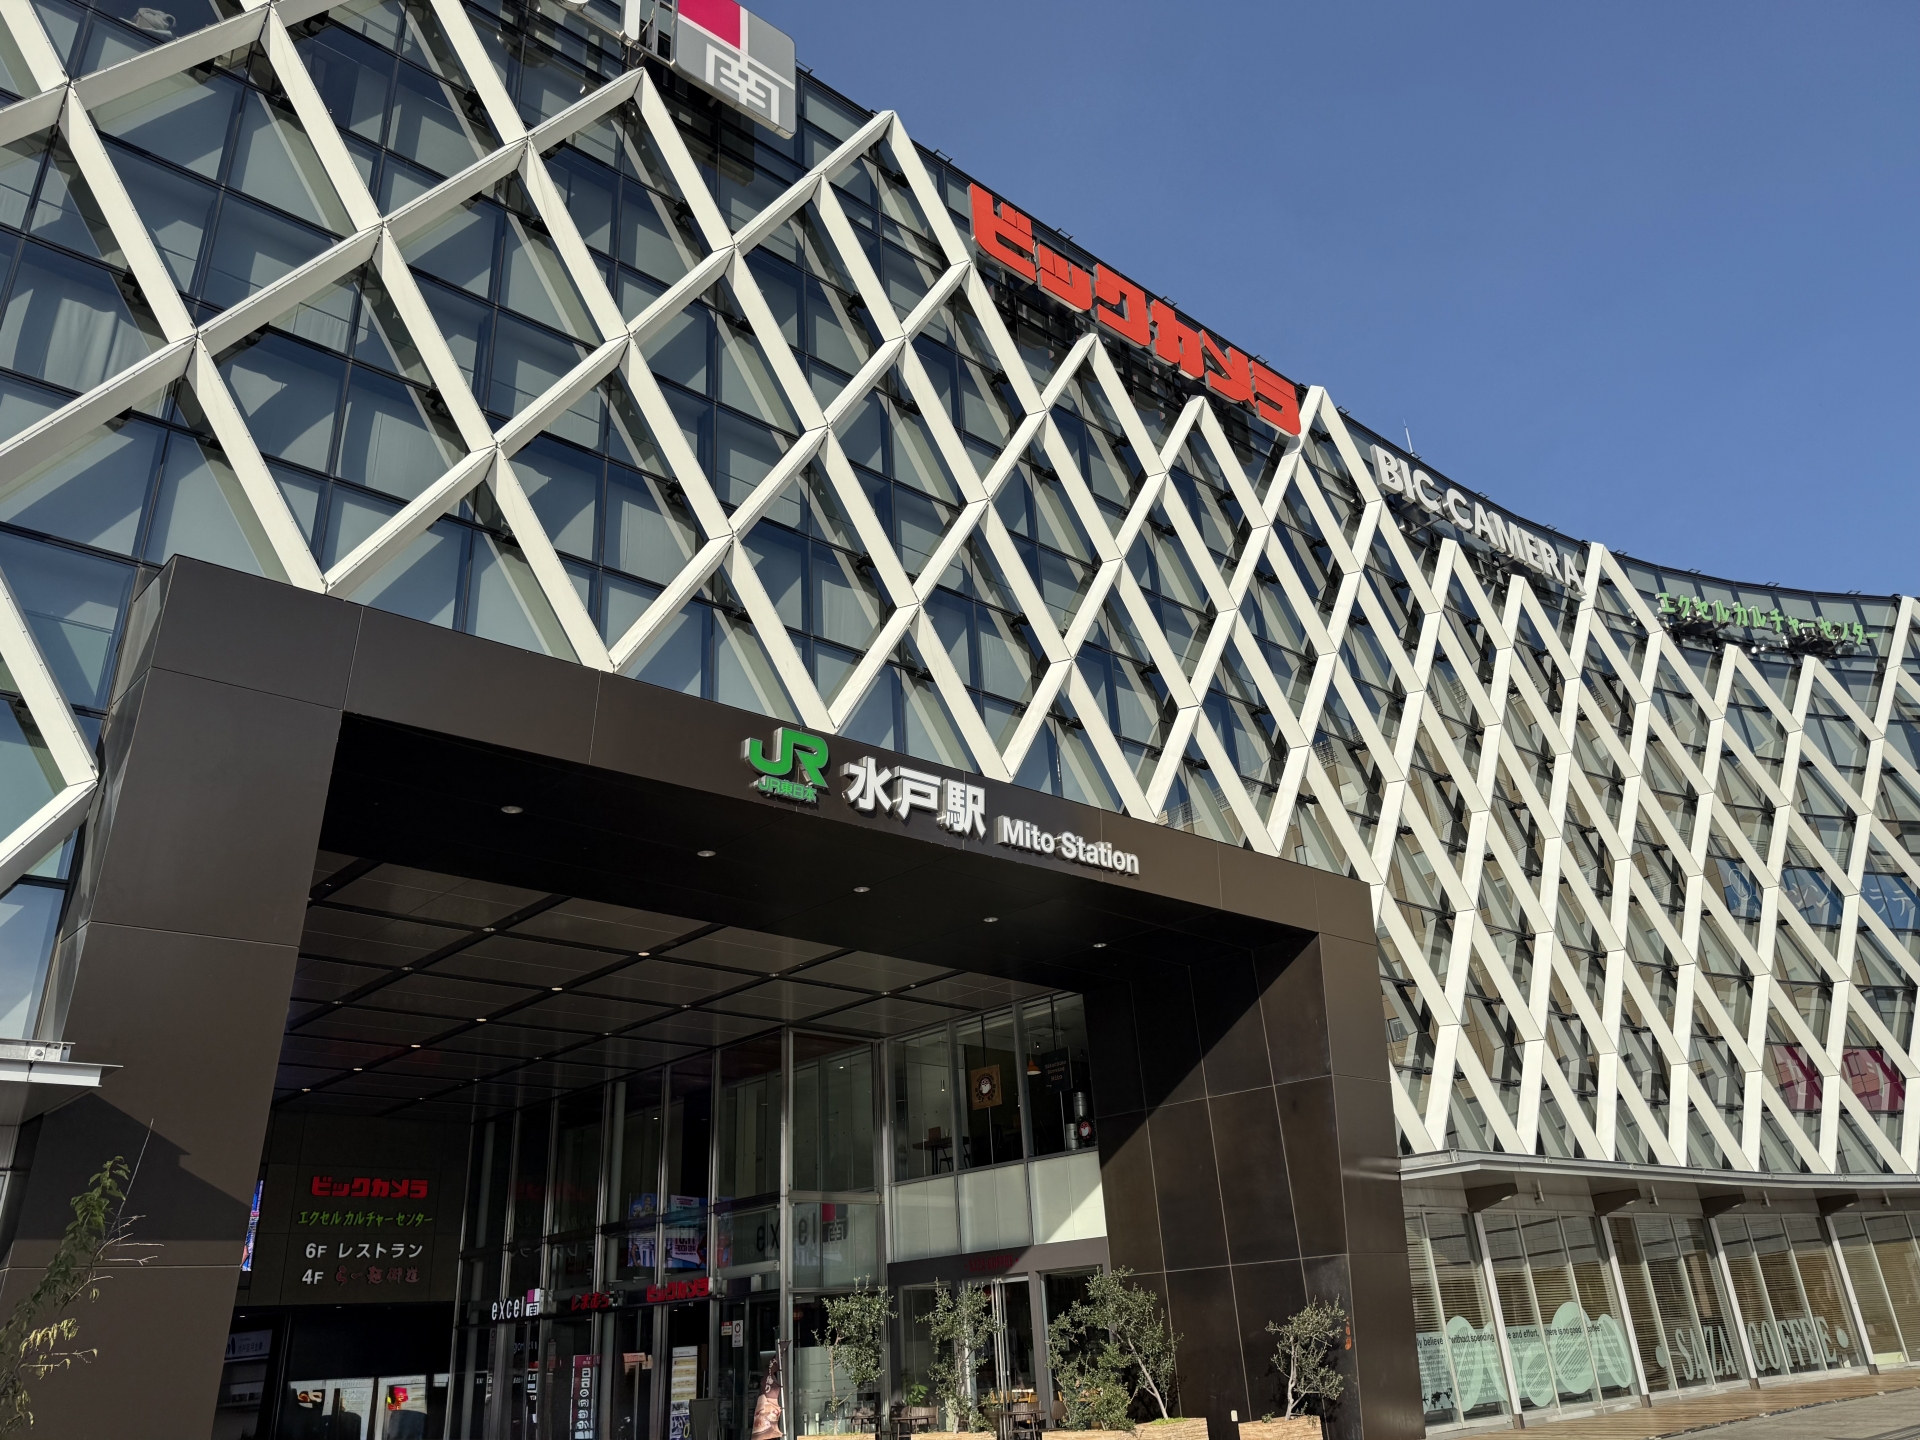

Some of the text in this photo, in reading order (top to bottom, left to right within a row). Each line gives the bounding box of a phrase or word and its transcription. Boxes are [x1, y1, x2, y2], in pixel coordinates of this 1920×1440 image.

[967, 182, 1301, 437] ビックカメラ
[1370, 443, 1587, 597] BIC CAMERA
[741, 727, 829, 788] JR
[749, 775, 819, 803] JR東日本
[840, 756, 1140, 876] 水戸駅 Mito Station
[310, 1175, 429, 1199] ビックカメラ
[305, 1242, 423, 1259] 6F レストラン
[301, 1268, 324, 1285] 4F
[646, 1276, 710, 1303] ビックカメラ
[491, 1296, 525, 1321] excel
[570, 1291, 611, 1312] しまむら
[1423, 1336, 1444, 1346] believe
[1470, 1332, 1495, 1344] spending
[1512, 1329, 1523, 1339] and
[1544, 1327, 1558, 1336] there
[1562, 1327, 1570, 1335] no
[1569, 1326, 1582, 1336] good
[1675, 1326, 1738, 1381] SAZA
[1748, 1316, 1838, 1372] COFFEE
